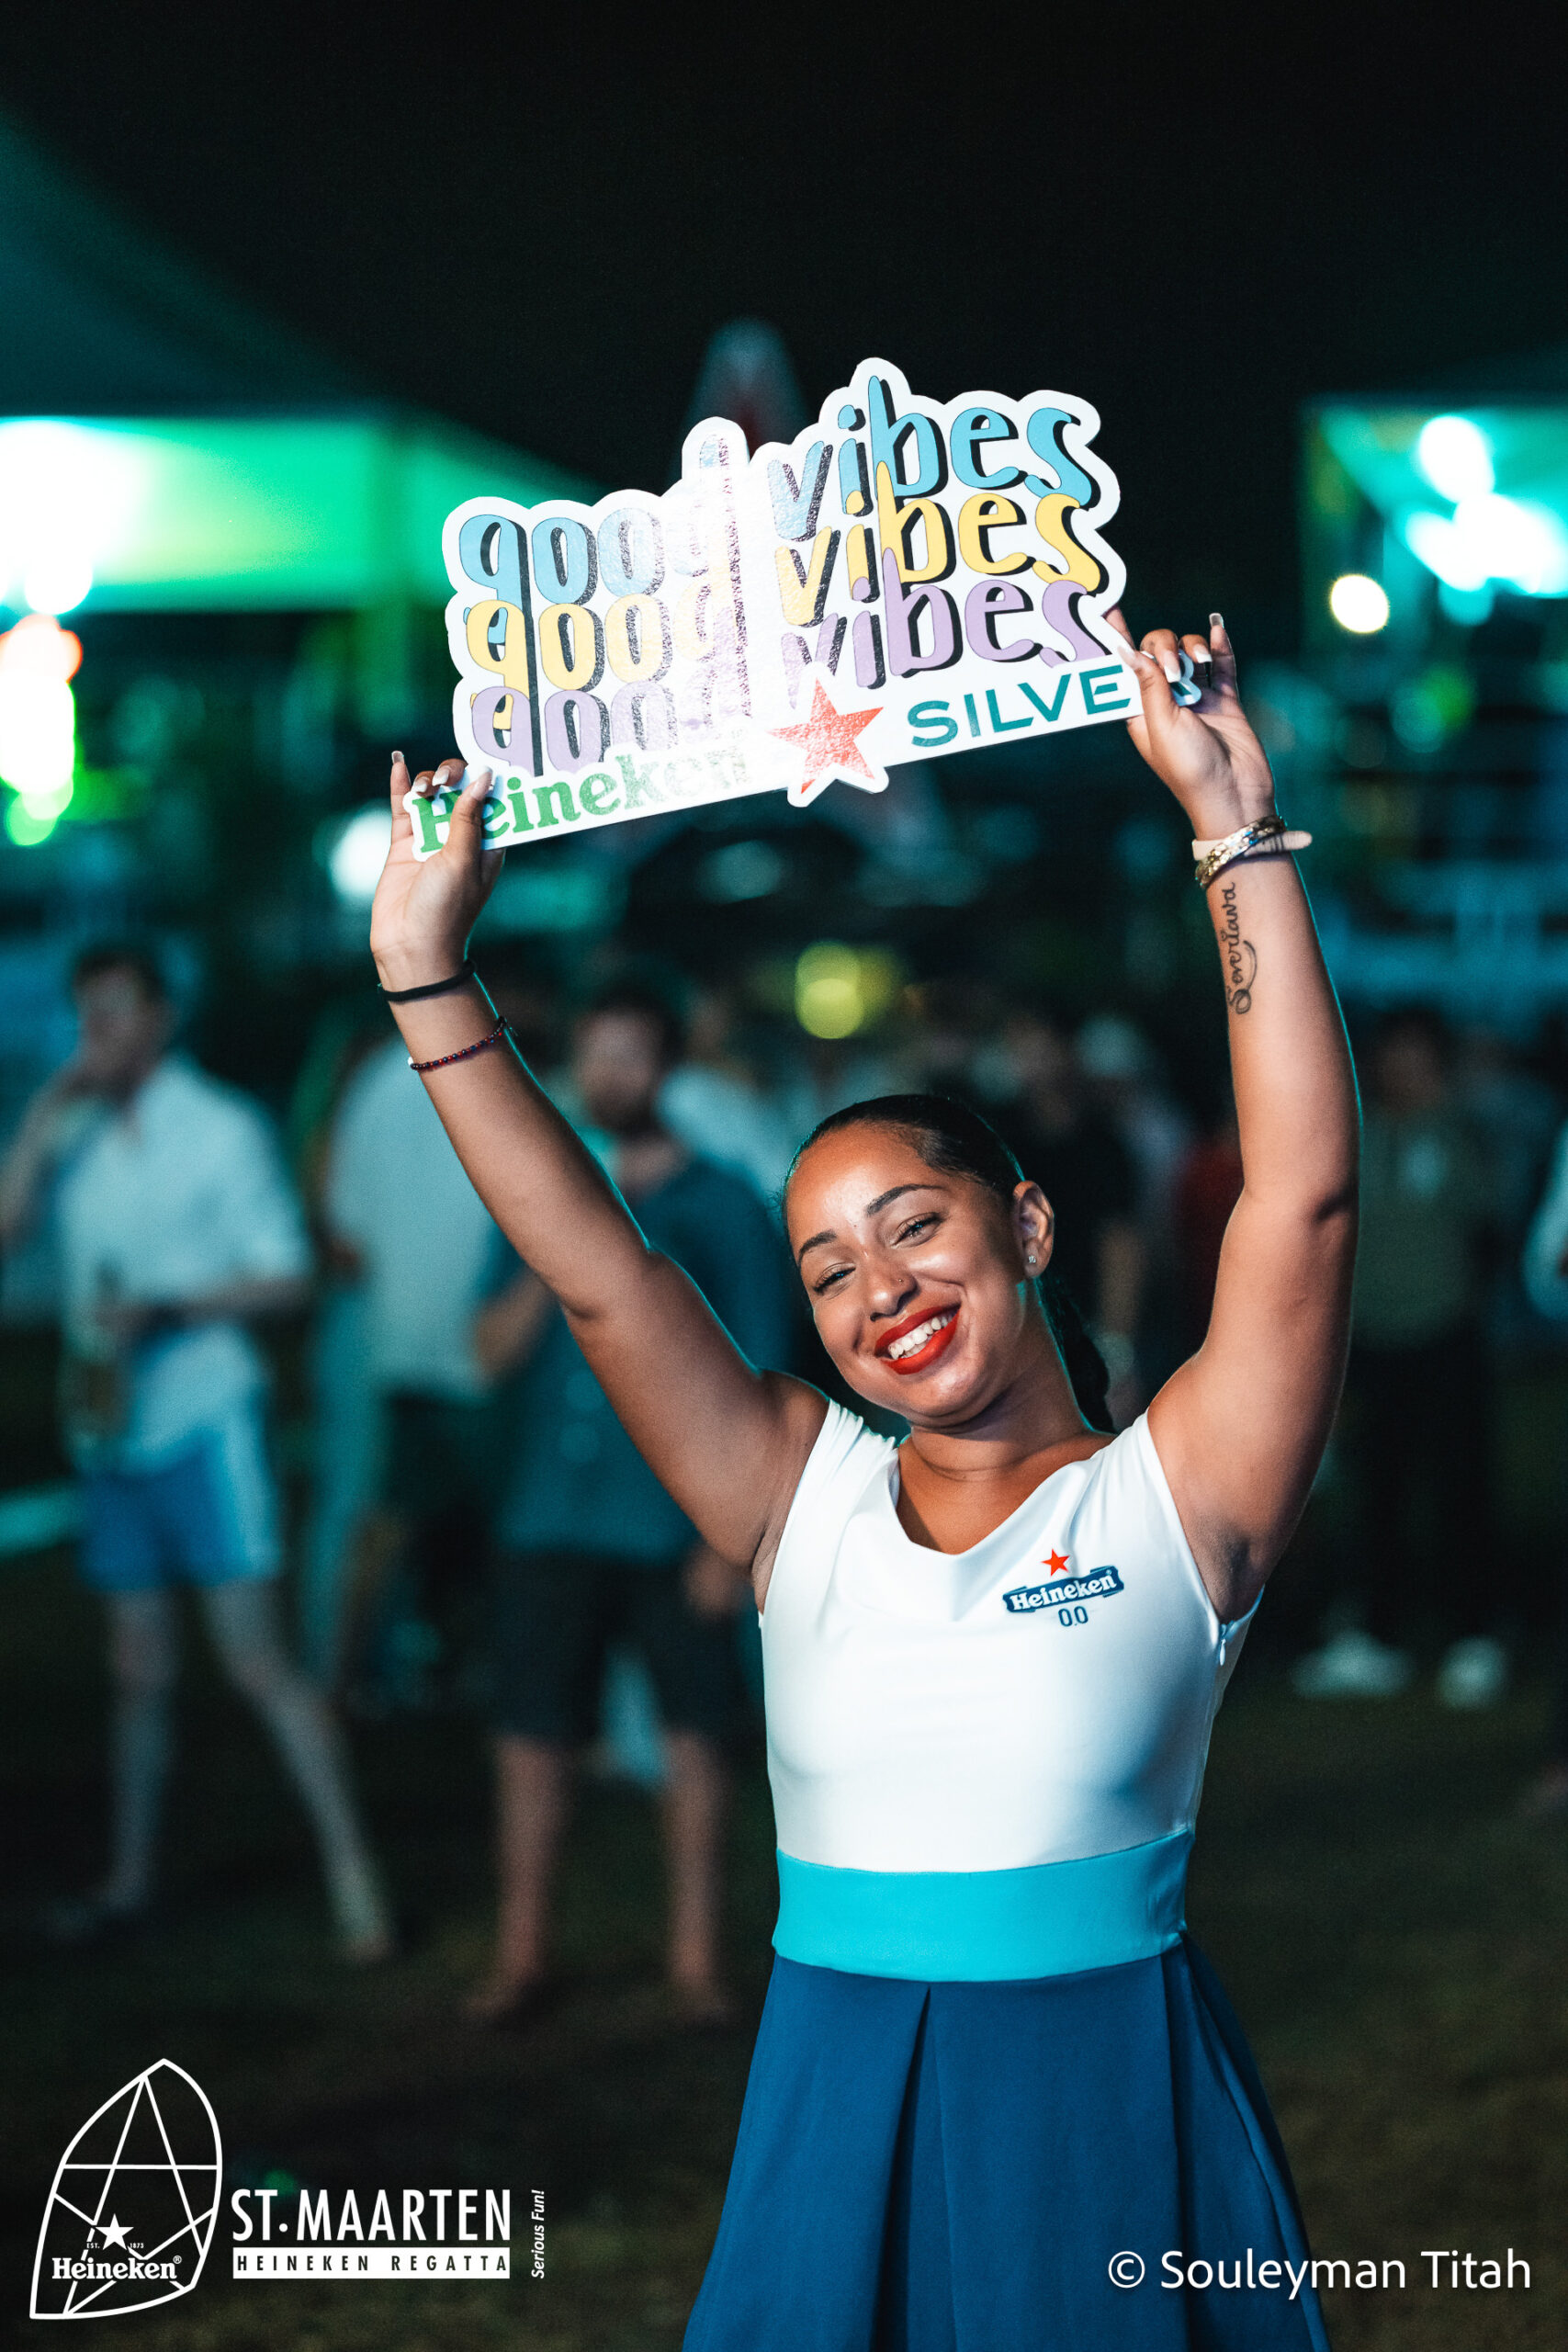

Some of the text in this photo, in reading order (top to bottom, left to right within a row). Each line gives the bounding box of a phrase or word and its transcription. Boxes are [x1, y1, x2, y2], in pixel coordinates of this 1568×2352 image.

[458, 376, 1093, 634] good vibes
[774, 461, 1109, 628] vibes
[781, 548, 1112, 709] vibes
